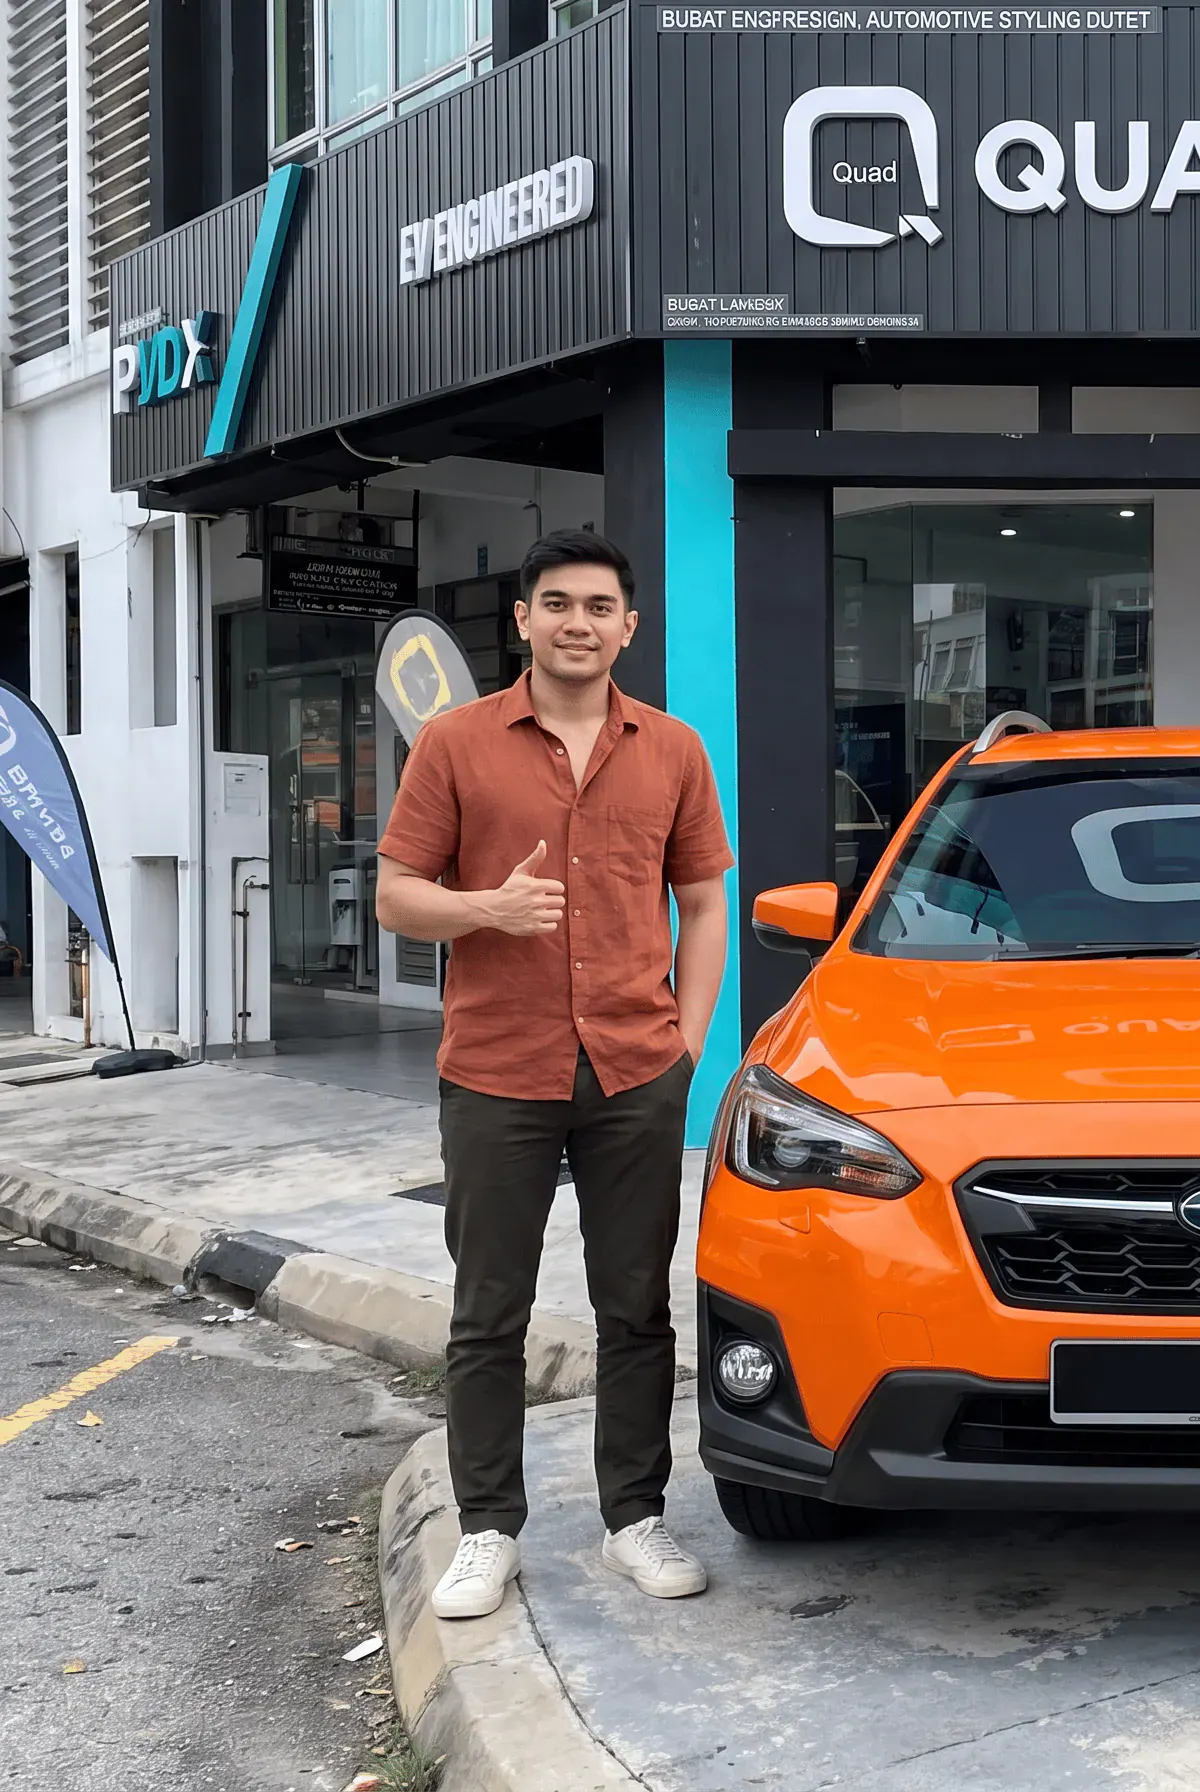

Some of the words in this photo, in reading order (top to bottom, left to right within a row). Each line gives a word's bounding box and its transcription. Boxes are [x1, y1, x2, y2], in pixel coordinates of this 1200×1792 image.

[662, 10, 727, 28] BUBAT
[866, 10, 994, 28] AUTOMOTIVE
[999, 10, 1081, 29] STYLING
[1087, 11, 1151, 28] DUTET
[832, 160, 897, 184] Quad
[433, 155, 594, 273] ENGINEERED
